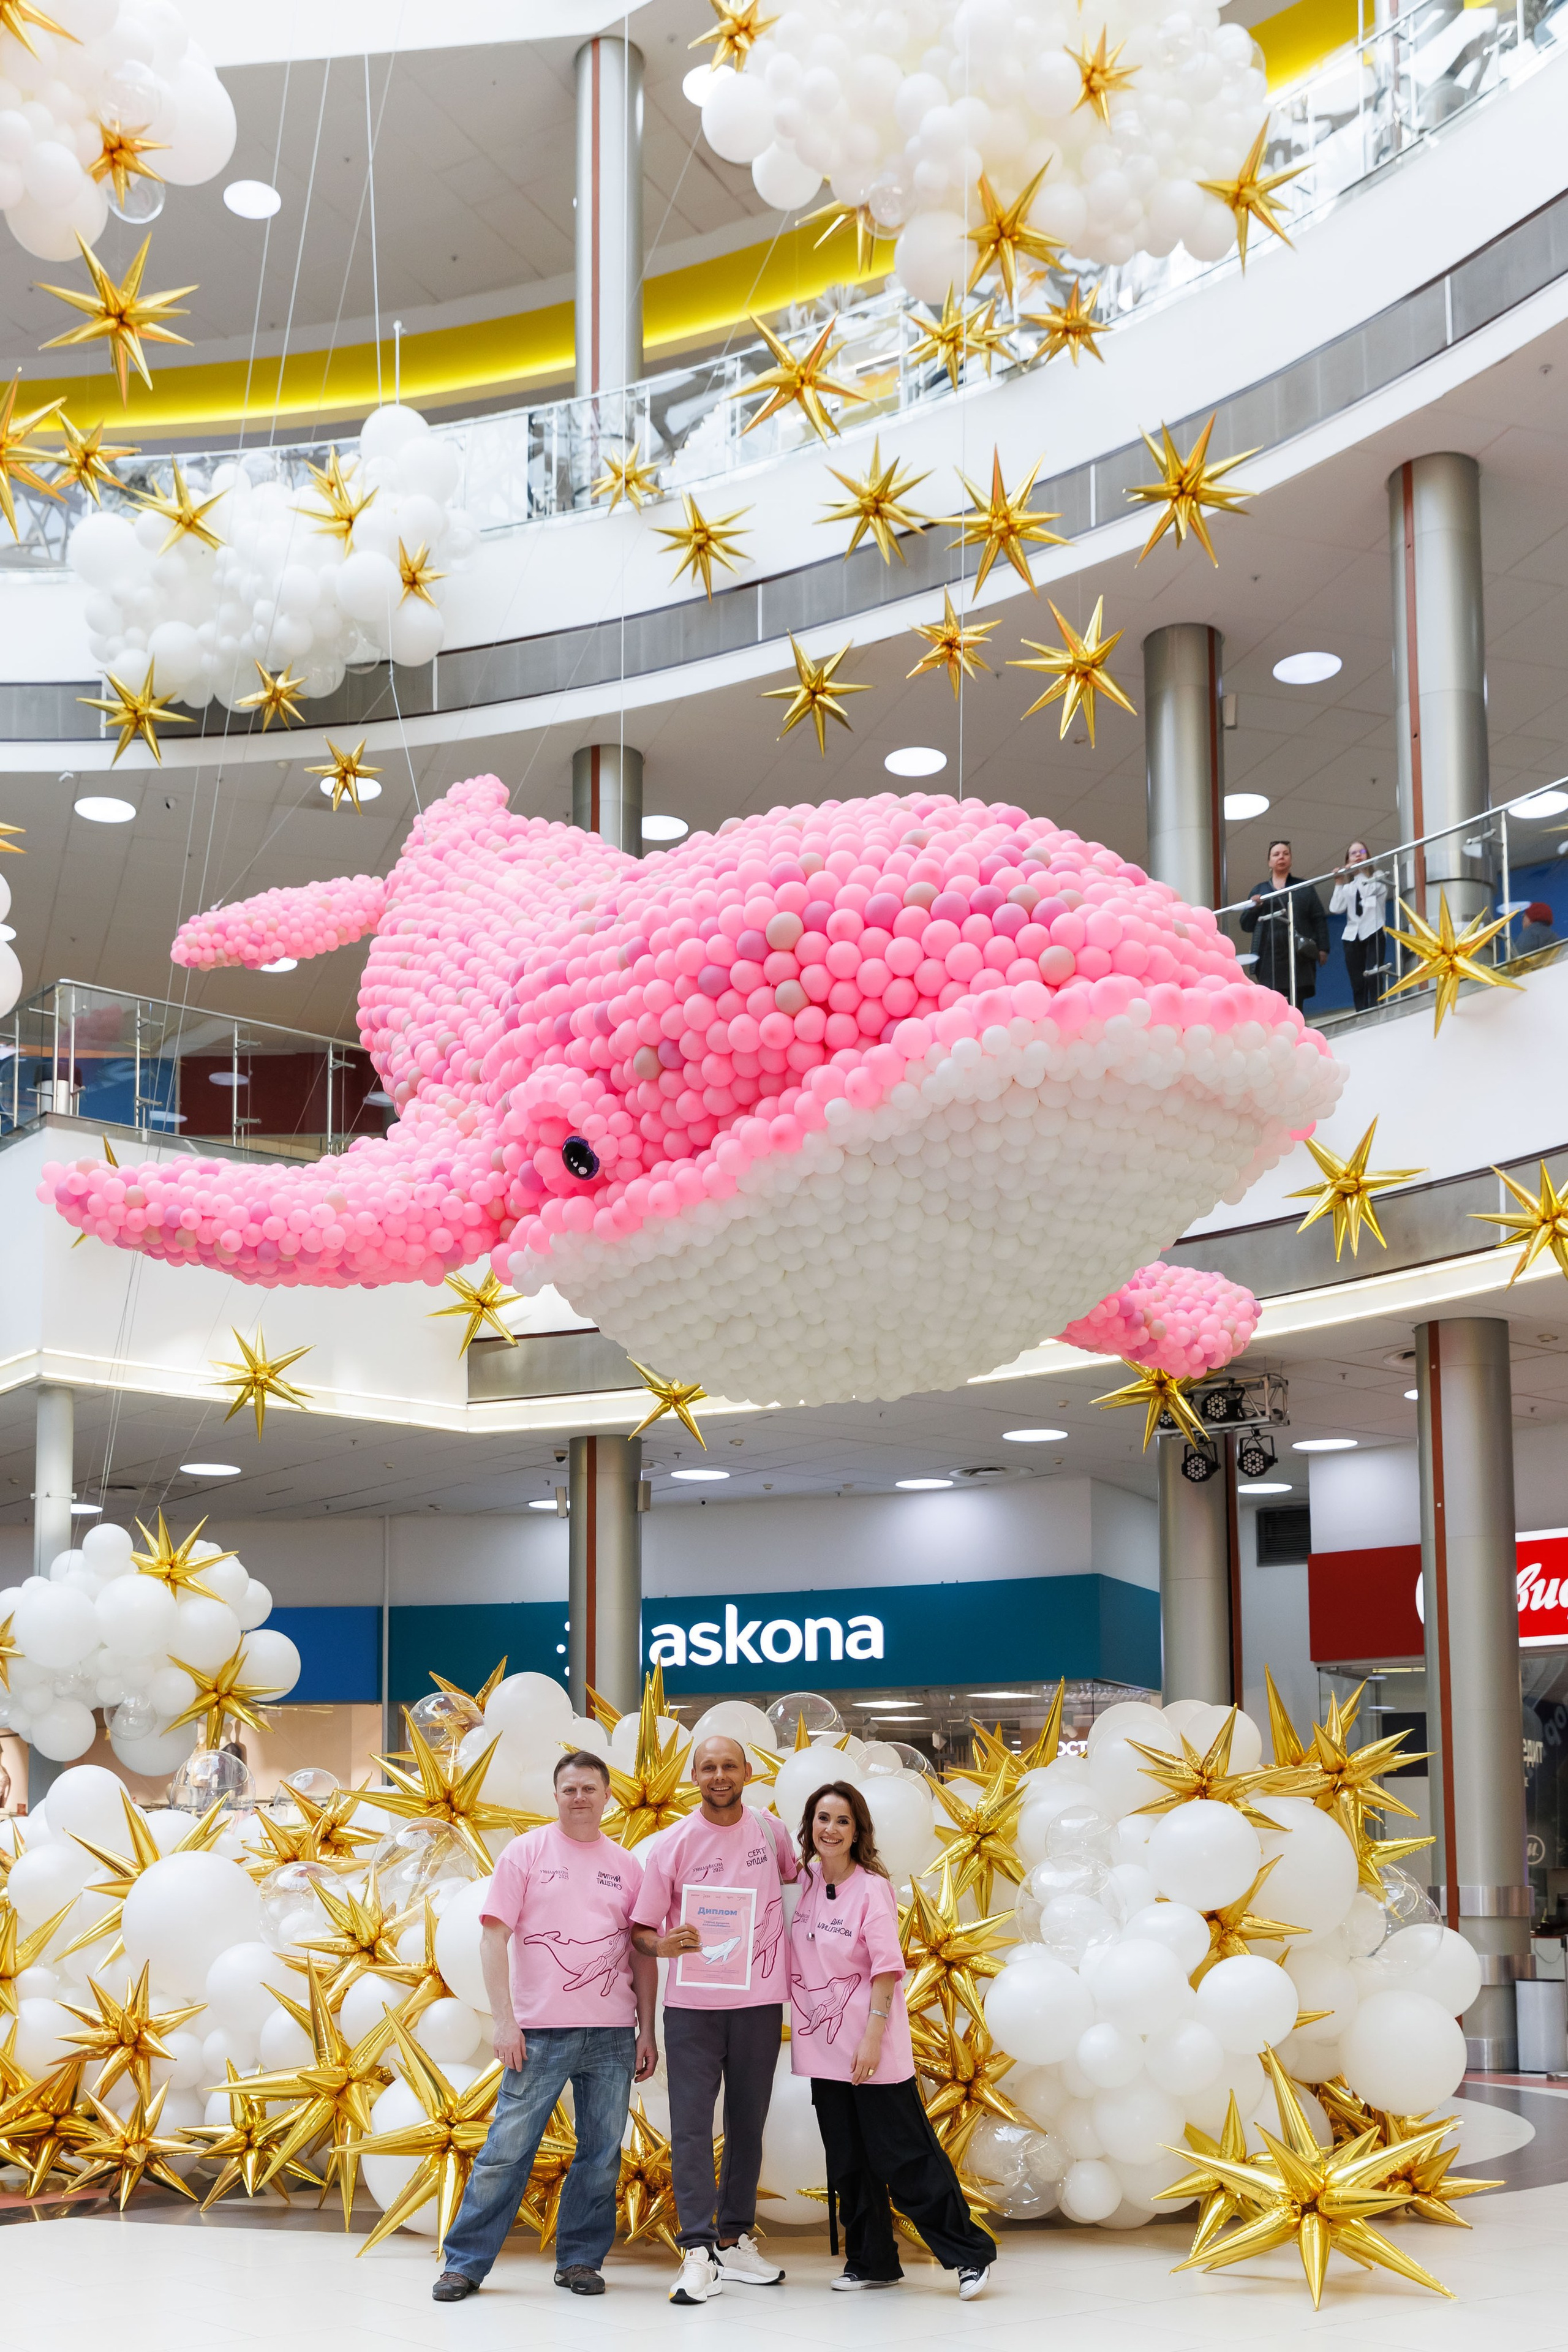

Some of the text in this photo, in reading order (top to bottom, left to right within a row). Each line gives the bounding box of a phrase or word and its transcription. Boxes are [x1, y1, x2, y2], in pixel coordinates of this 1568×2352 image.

[649, 1604, 884, 1667] askona
[597, 1871, 621, 1883] ДМИТРИЙ
[697, 1907, 737, 1916] Диплом
